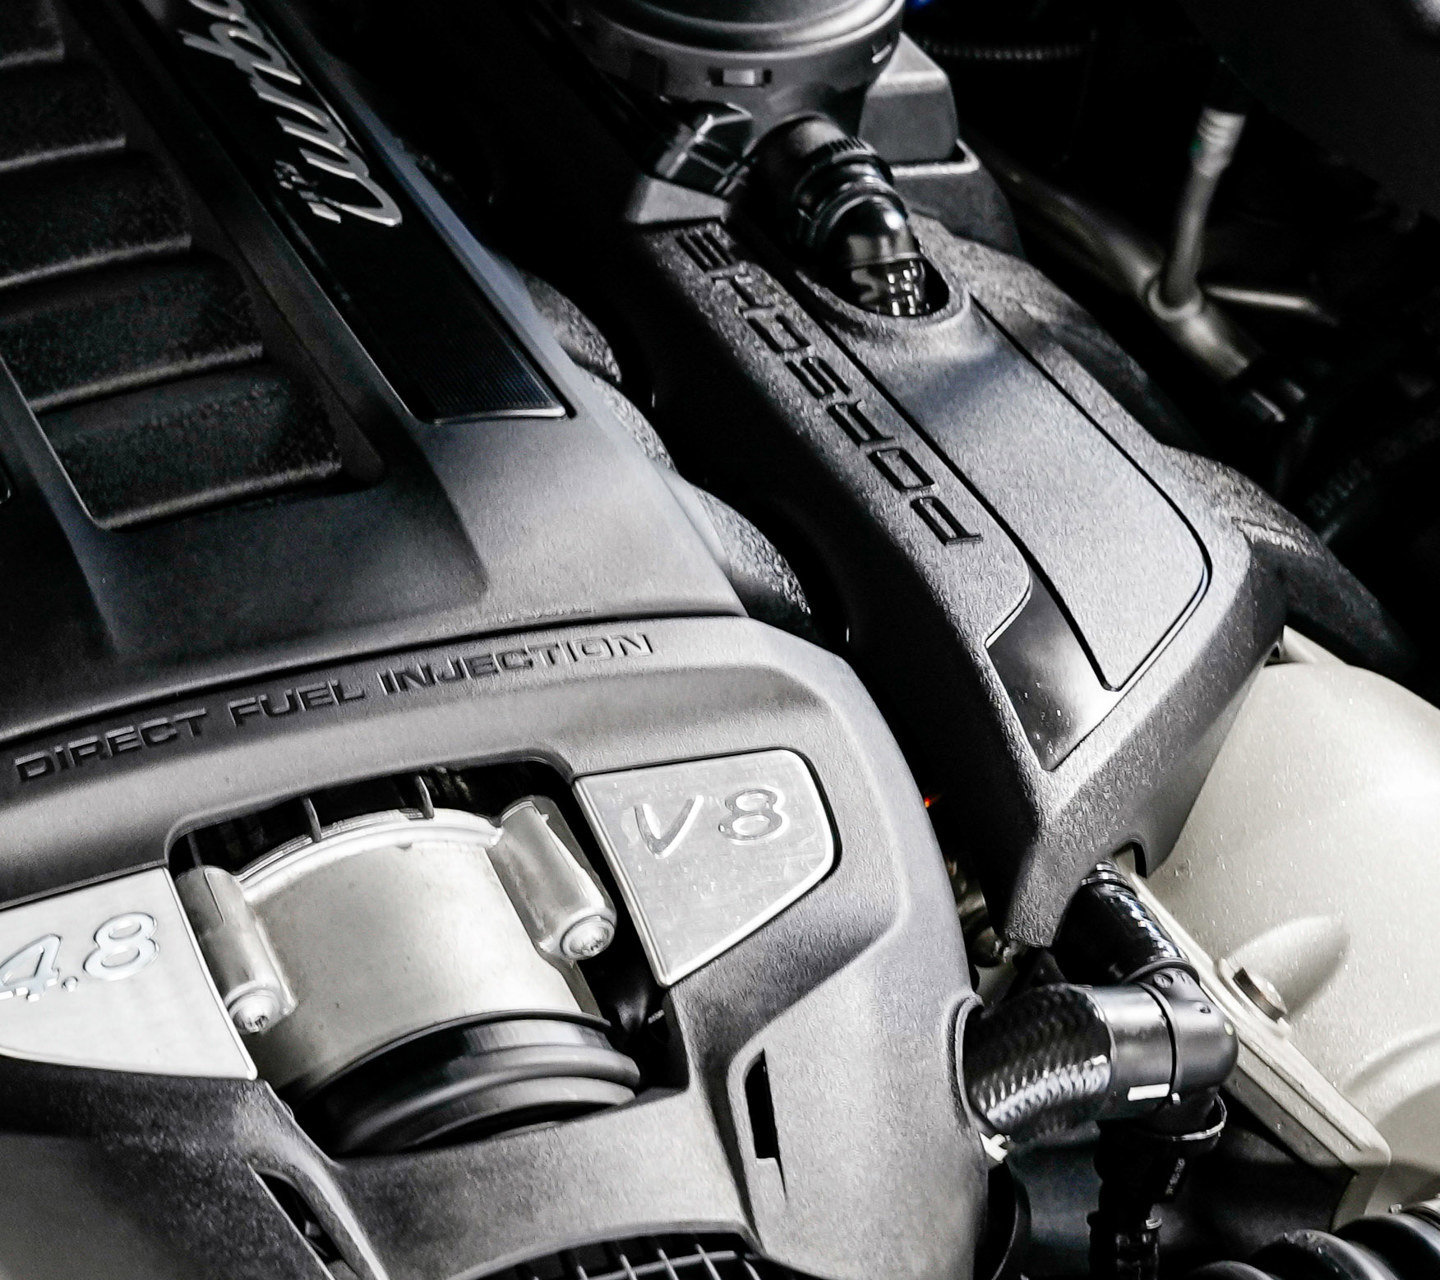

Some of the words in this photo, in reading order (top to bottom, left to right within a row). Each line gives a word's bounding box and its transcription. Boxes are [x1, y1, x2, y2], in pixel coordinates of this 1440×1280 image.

[675, 231, 982, 546] PORSCHE
[15, 709, 208, 784] DIRECT
[229, 676, 364, 729] FUEL
[379, 631, 655, 697] INJECTION
